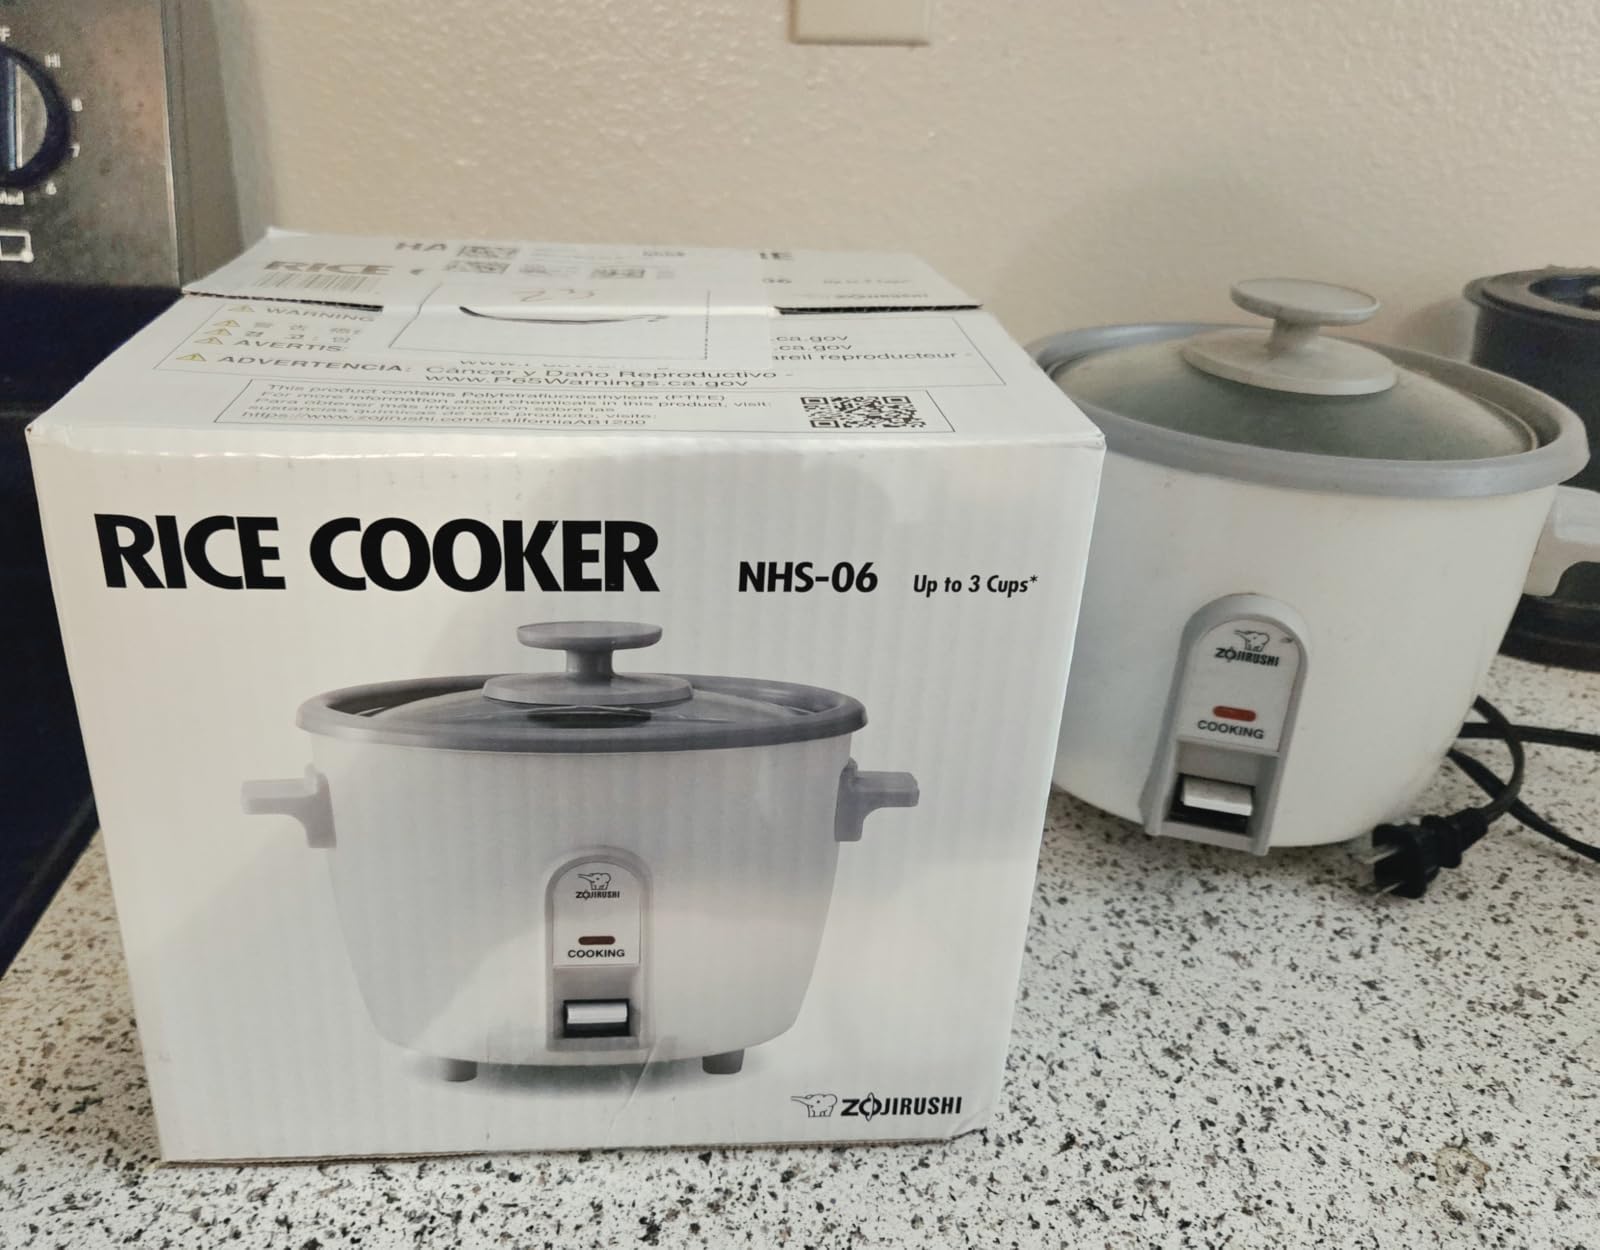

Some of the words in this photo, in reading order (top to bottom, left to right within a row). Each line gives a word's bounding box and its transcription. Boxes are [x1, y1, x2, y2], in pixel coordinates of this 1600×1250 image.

[264, 260, 394, 276] RICE
[266, 306, 376, 323] WARNING
[233, 339, 343, 352] AVERTIS
[820, 352, 958, 362] reproducteur
[425, 375, 749, 388] www.P65Warnings.ca.gov
[619, 370, 777, 380] Reproductivo
[268, 384, 305, 392] This
[381, 389, 456, 398] contains
[350, 394, 449, 404] information
[93, 512, 286, 591] RICE
[309, 516, 661, 593] COOKER
[738, 560, 879, 594] NHS-06
[913, 573, 938, 598] Up
[944, 575, 962, 593] to
[968, 574, 981, 593] 3
[1214, 646, 1280, 667] ZOJIRUSHI
[1197, 720, 1265, 740] COOKING
[575, 889, 621, 900] ZOJIRUSHI
[567, 949, 625, 958] COOKING
[840, 1093, 963, 1121] ZOJIRUSHI
